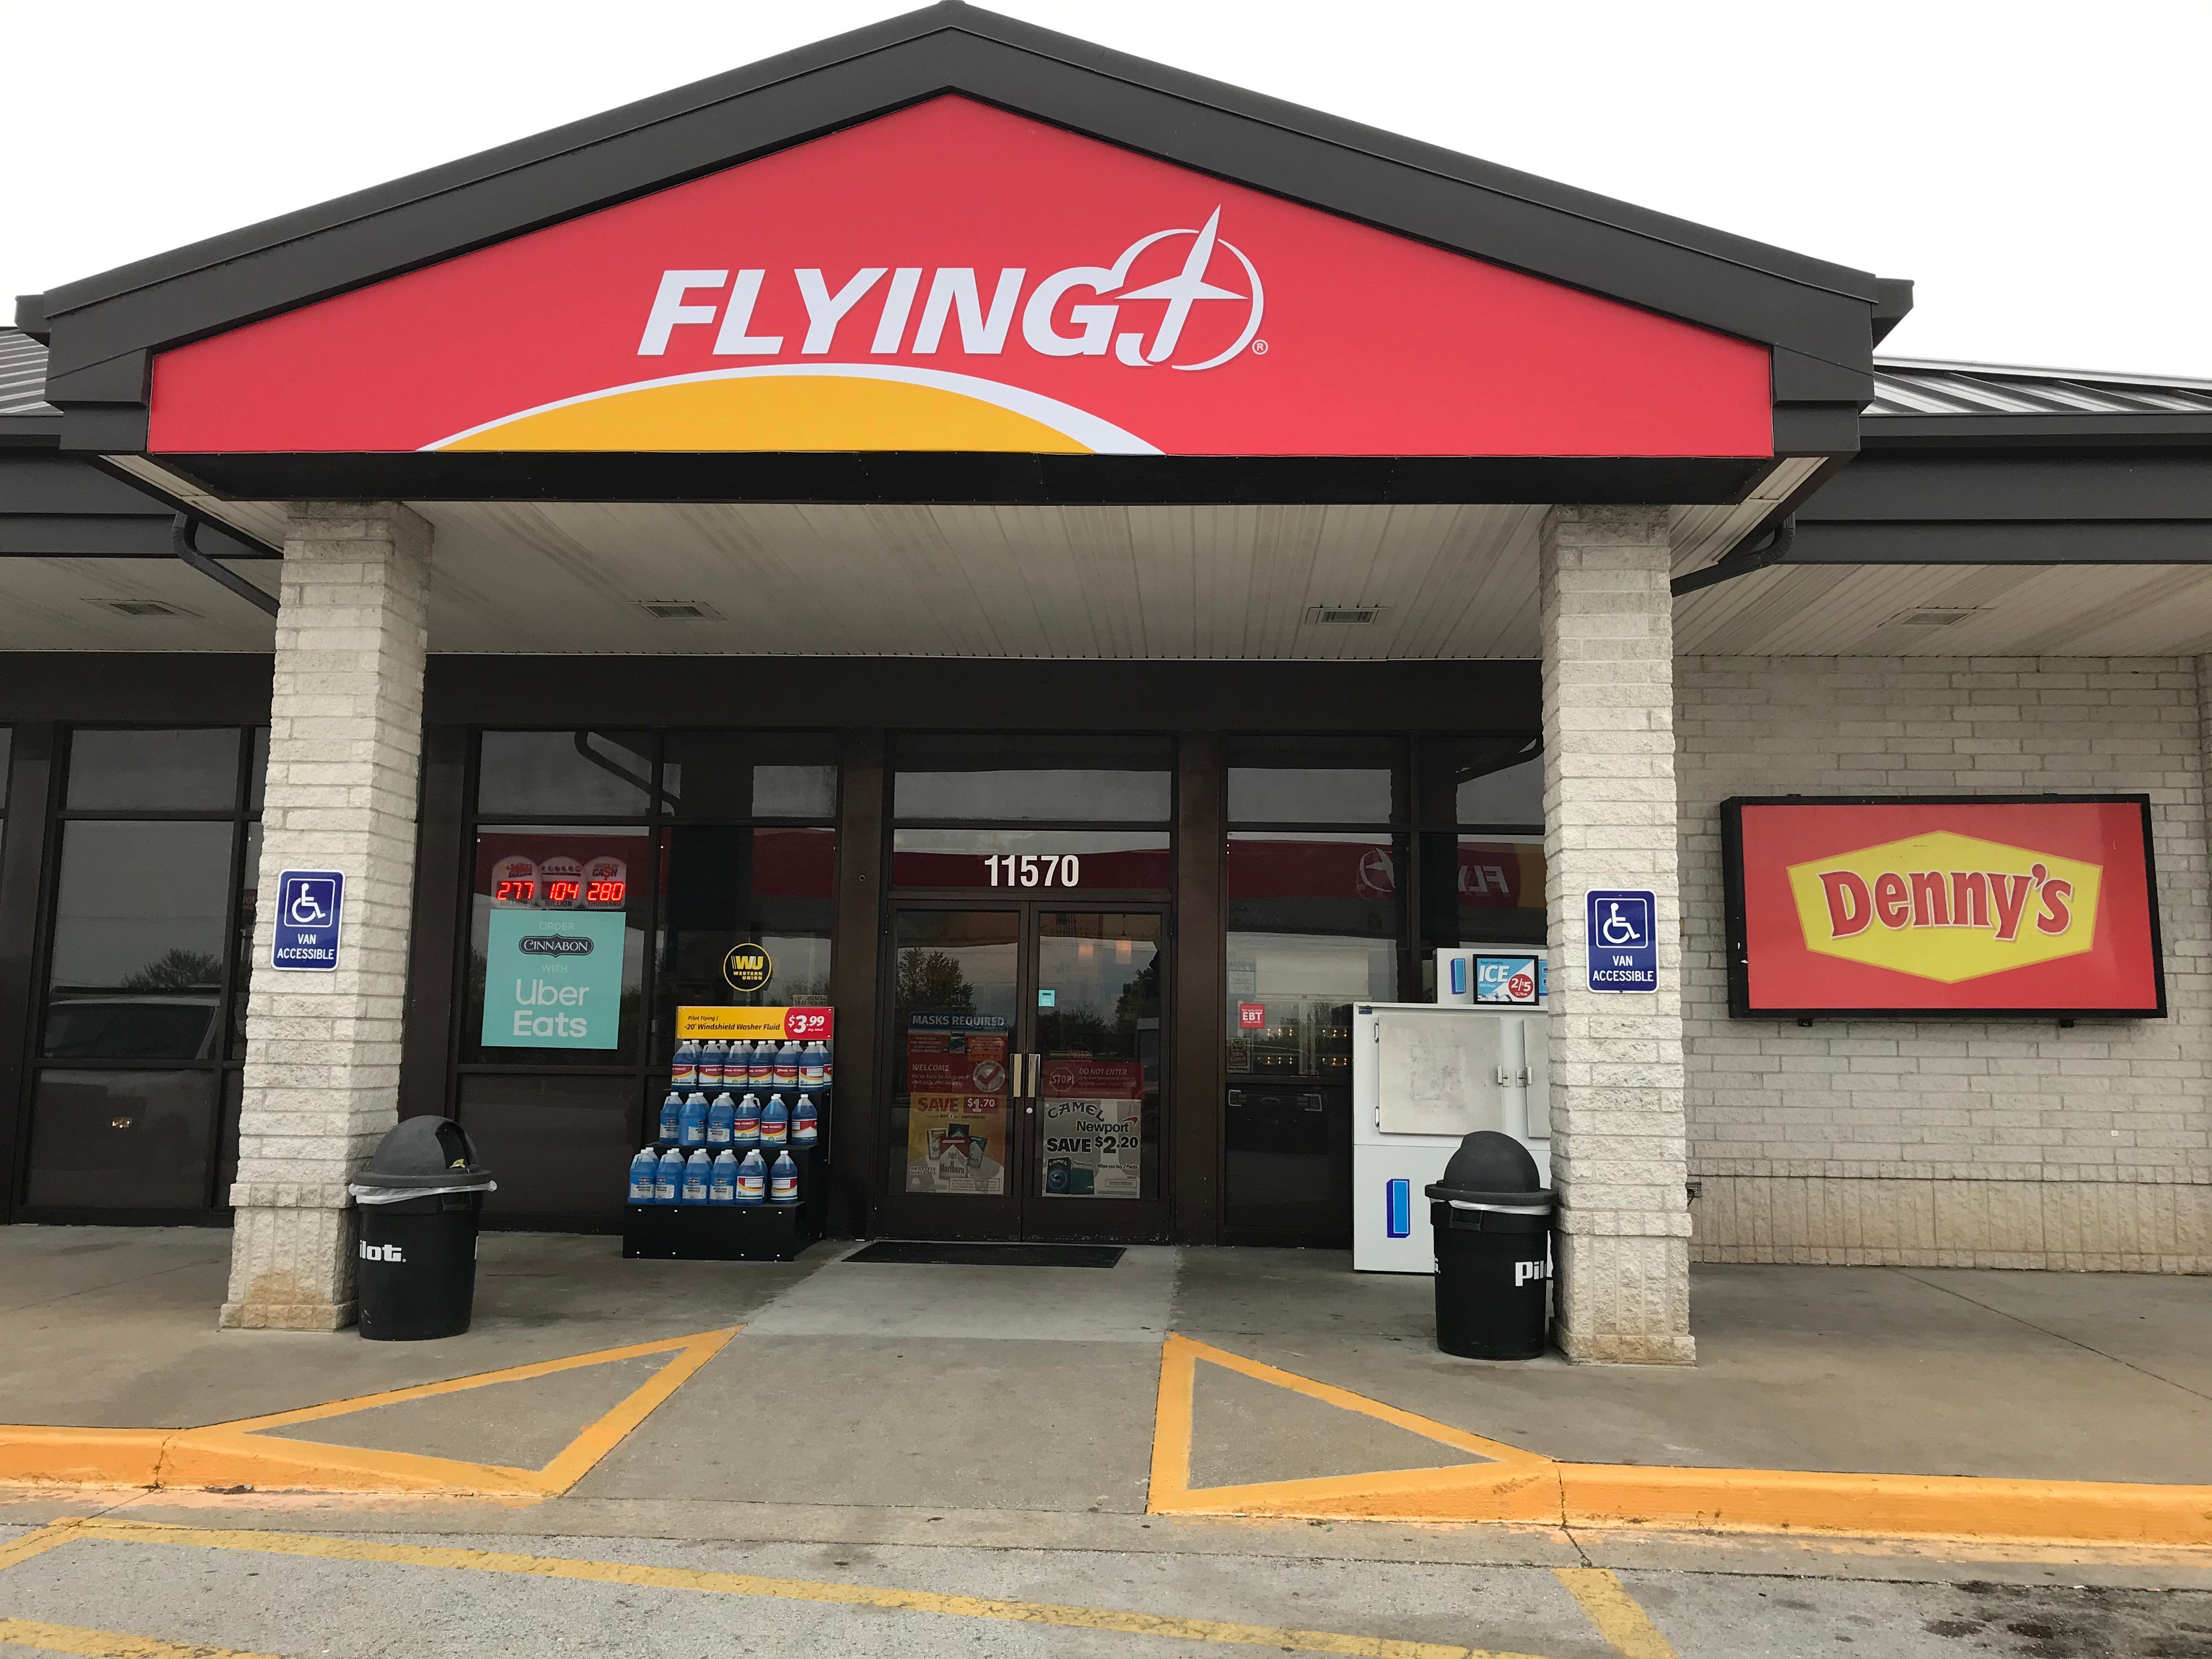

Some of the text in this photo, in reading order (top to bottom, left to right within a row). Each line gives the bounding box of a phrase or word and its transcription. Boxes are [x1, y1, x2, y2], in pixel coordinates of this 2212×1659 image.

[984, 854, 1079, 887] 11570
[496, 882, 534, 901] 277
[549, 882, 579, 901] 104
[587, 882, 625, 901] 280
[1818, 862, 2074, 941] Denny's
[539, 922, 575, 931] ORDER
[297, 933, 317, 945] VAN
[523, 939, 588, 952] CINNABON
[276, 947, 335, 960] ACCESSIBLE
[1612, 955, 1633, 967] VAN
[541, 964, 568, 973] WITH
[731, 955, 764, 970] WU
[1479, 964, 1510, 983] ICE
[1592, 970, 1655, 983] ACCESSIBLE
[516, 978, 590, 1006] Uber
[1511, 978, 1532, 992] 2/$5
[513, 1009, 588, 1038] Eats
[912, 1015, 1005, 1026] MASKS REQUIRED
[1242, 1012, 1263, 1020] EBT
[788, 1014, 825, 1034] $3.99
[911, 1063, 950, 1071] WELCOME
[1052, 1074, 1071, 1084] STOP
[917, 1097, 996, 1113] SAVE $1.70
[1047, 1102, 1105, 1122] CAMEL
[1076, 1120, 1130, 1135] Newport
[1046, 1135, 1139, 1154] SAVE $2.20
[939, 1160, 964, 1174] Marlboro
[359, 1239, 402, 1262] ilot
[1515, 1260, 1547, 1287] Pil
